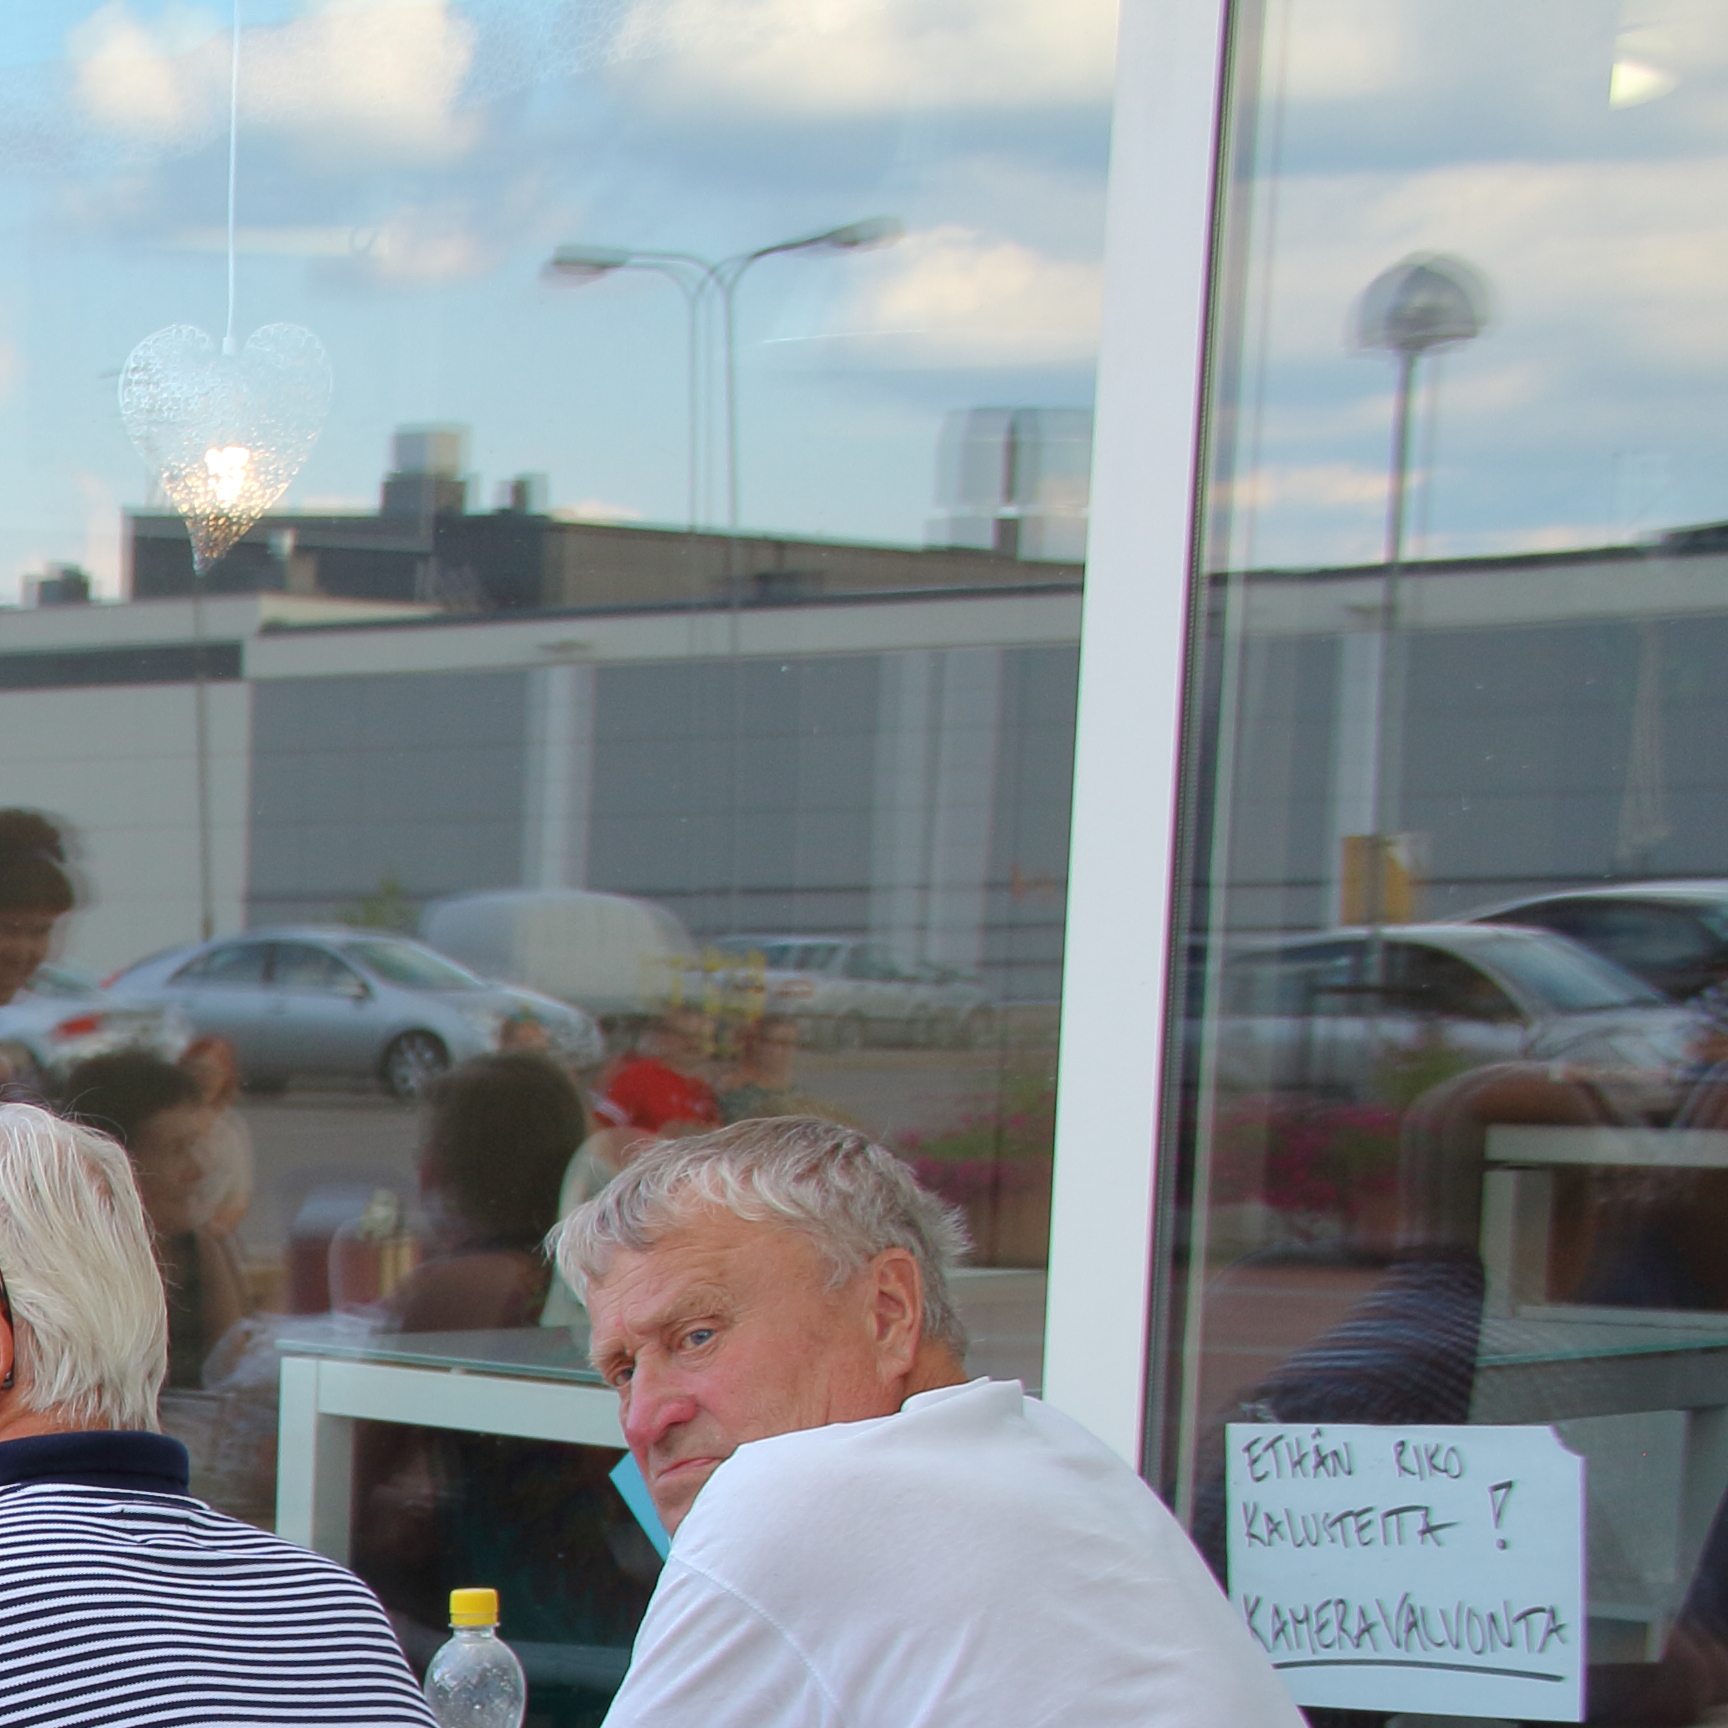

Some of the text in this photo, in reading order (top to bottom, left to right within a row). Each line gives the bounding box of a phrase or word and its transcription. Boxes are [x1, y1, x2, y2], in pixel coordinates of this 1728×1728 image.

[1392, 1440, 1463, 1480] RIKO
[1242, 1501, 1461, 1548] KALUSTEITA
[1242, 1592, 1568, 1656] KAMERAVALVONTA
